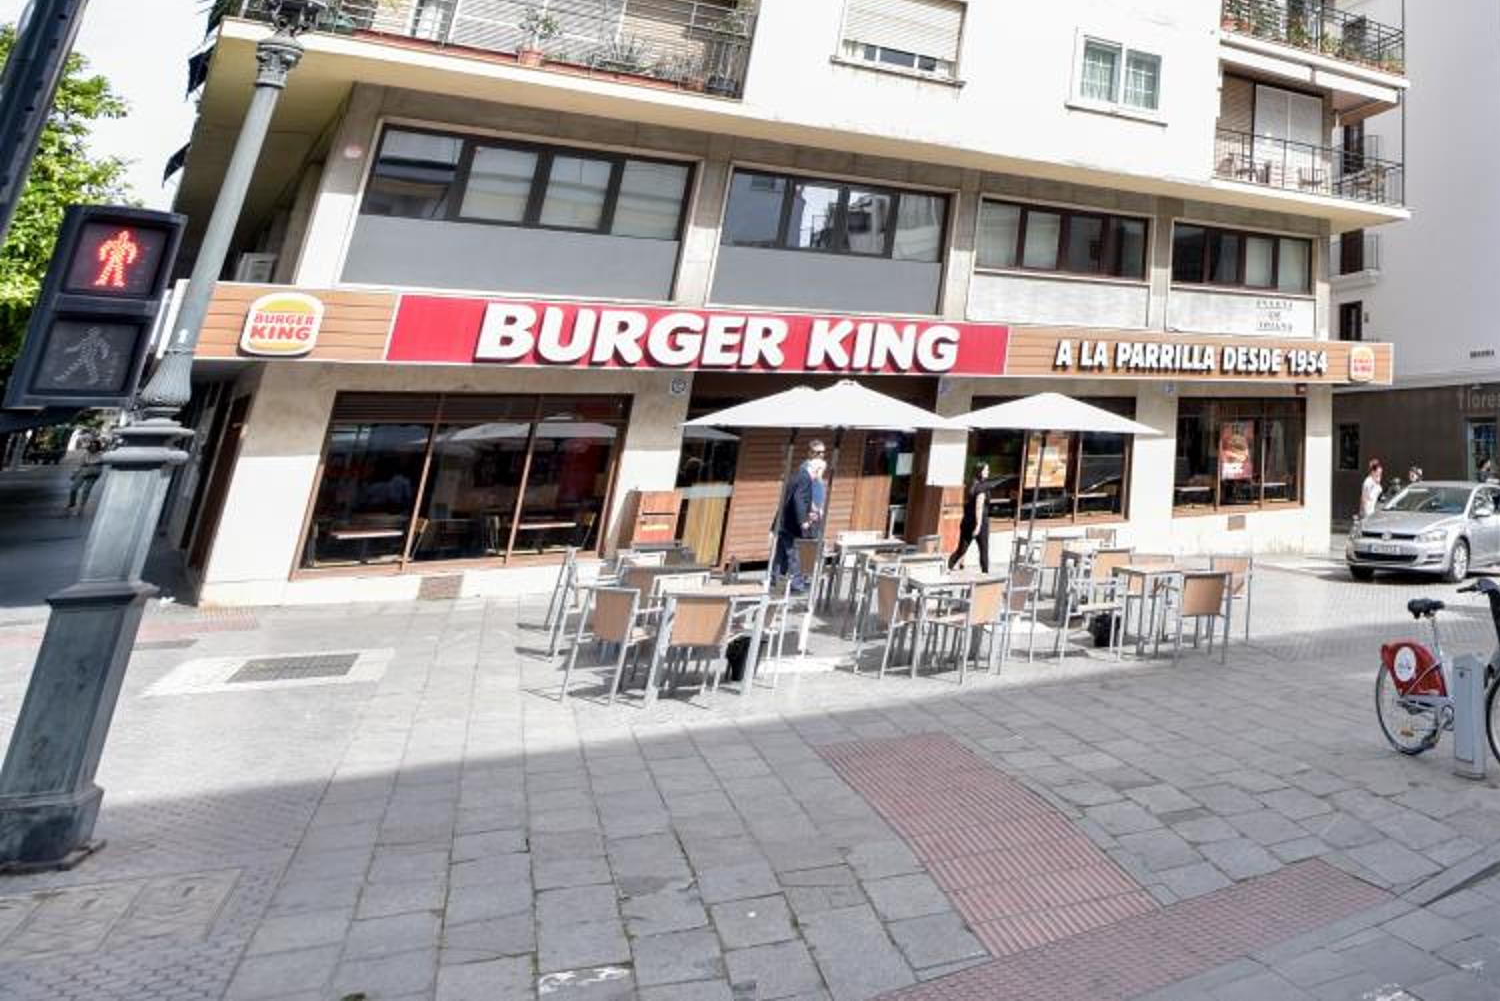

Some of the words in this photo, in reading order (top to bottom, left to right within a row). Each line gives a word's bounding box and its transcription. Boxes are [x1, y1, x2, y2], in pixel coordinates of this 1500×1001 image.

[254, 313, 315, 326] BURGER
[249, 326, 312, 341] KING
[475, 302, 789, 367] BURGER
[808, 318, 960, 371] KING
[1055, 341, 1072, 367] A
[1080, 341, 1108, 367] LA
[1115, 342, 1216, 370] PARRILLA
[1222, 346, 1282, 372] DESDE
[1287, 349, 1328, 374] 1954
